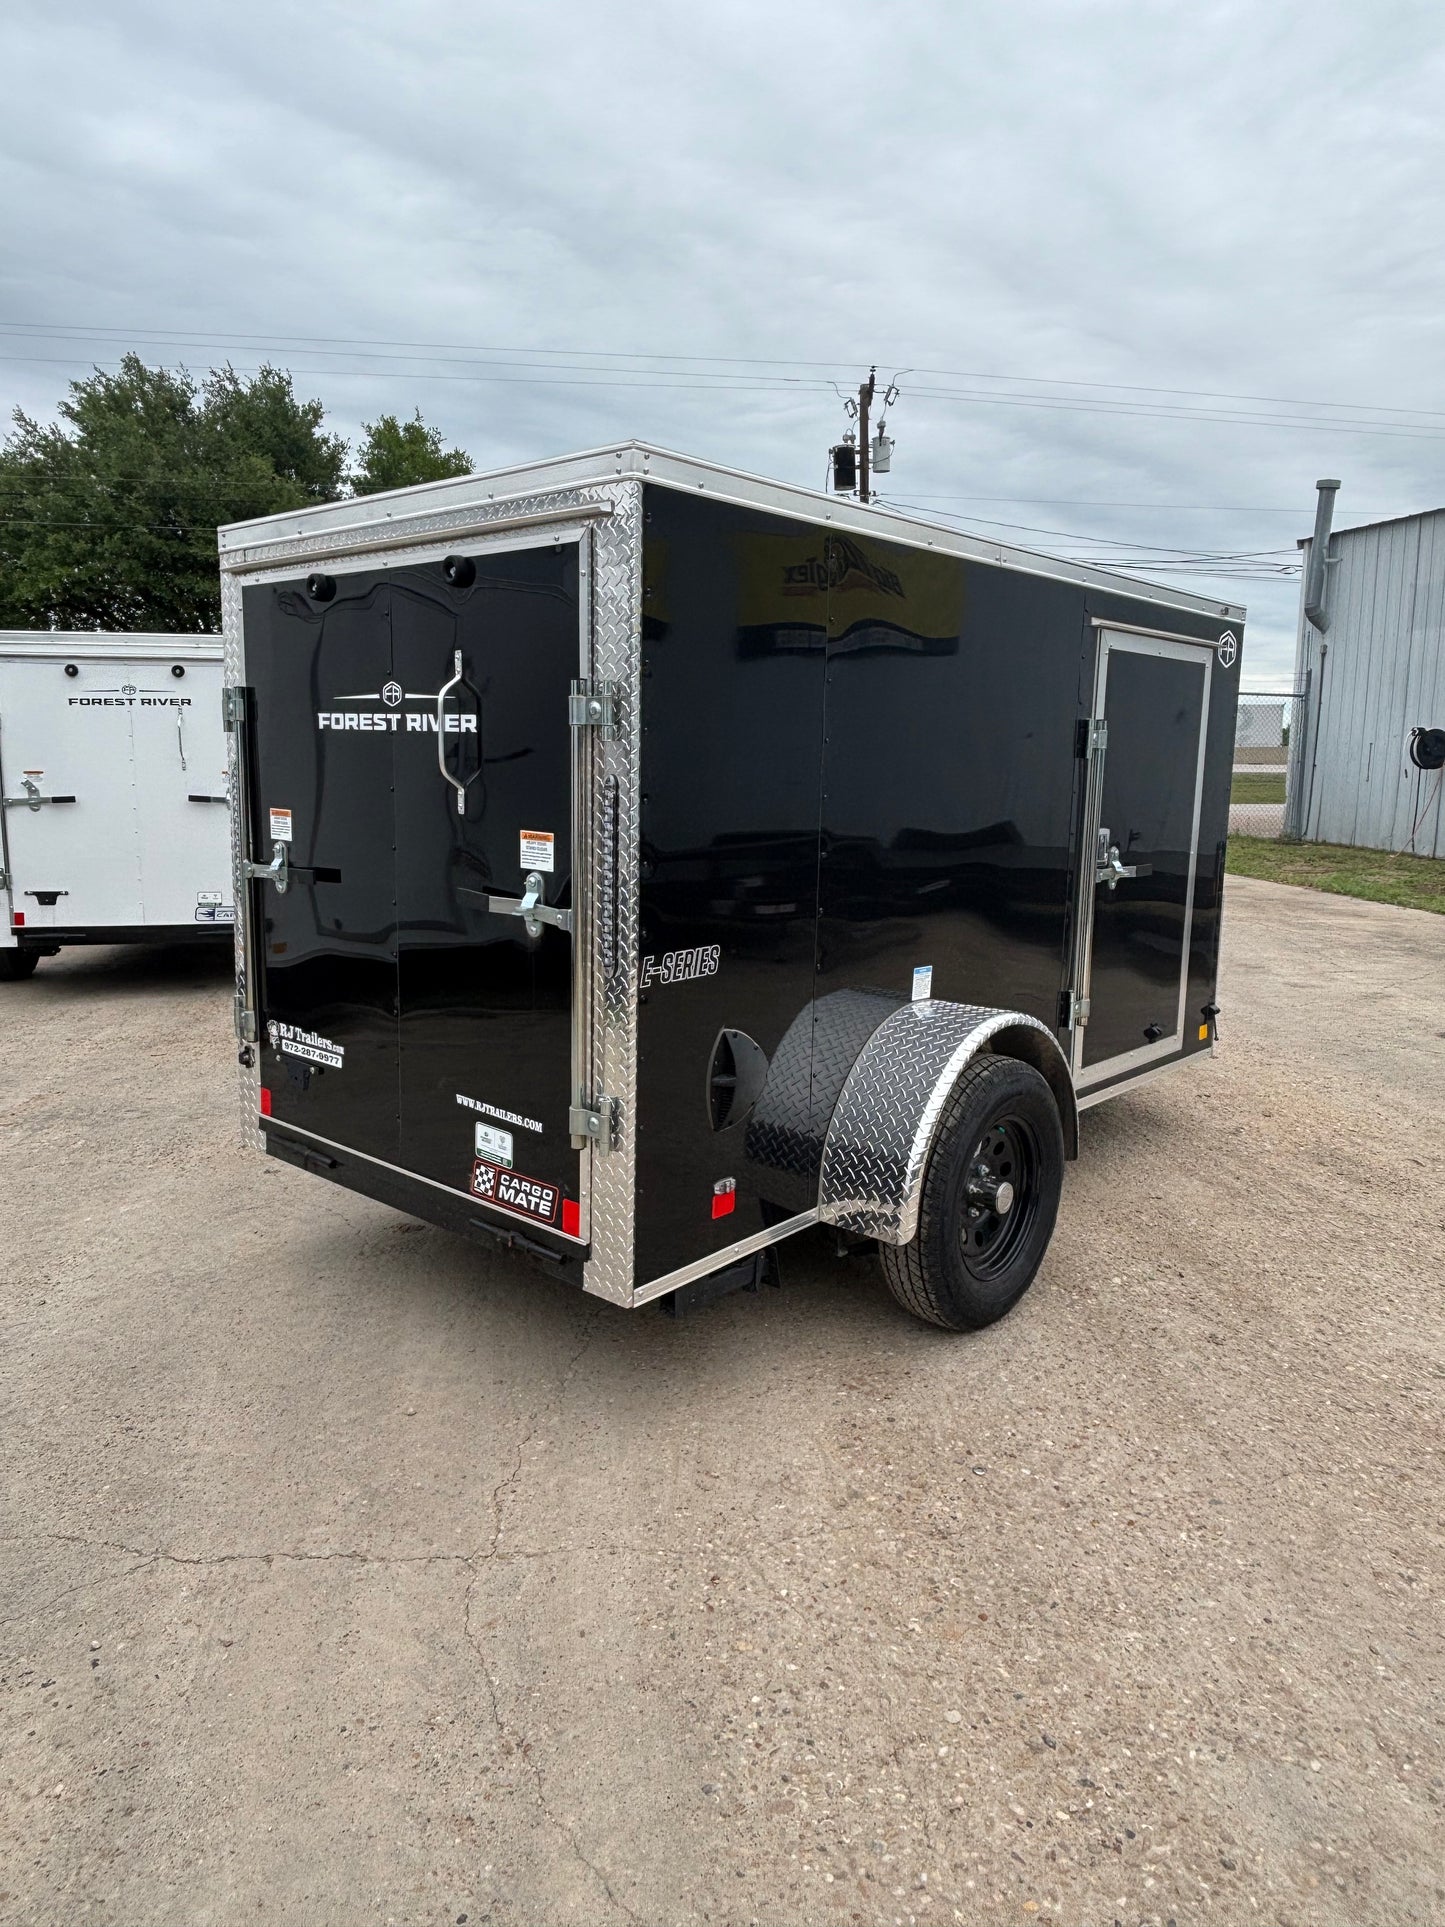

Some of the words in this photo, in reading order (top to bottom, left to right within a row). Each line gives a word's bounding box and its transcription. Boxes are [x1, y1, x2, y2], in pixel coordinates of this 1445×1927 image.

[67, 698, 136, 706] FOREST
[140, 698, 192, 706] RIVER
[317, 712, 401, 731] FOREST
[405, 713, 478, 733] RIVER
[640, 944, 720, 988] E-SERIES
[279, 1022, 294, 1039] RJ
[500, 1174, 554, 1201] CARGO
[498, 1185, 552, 1216] MATE
